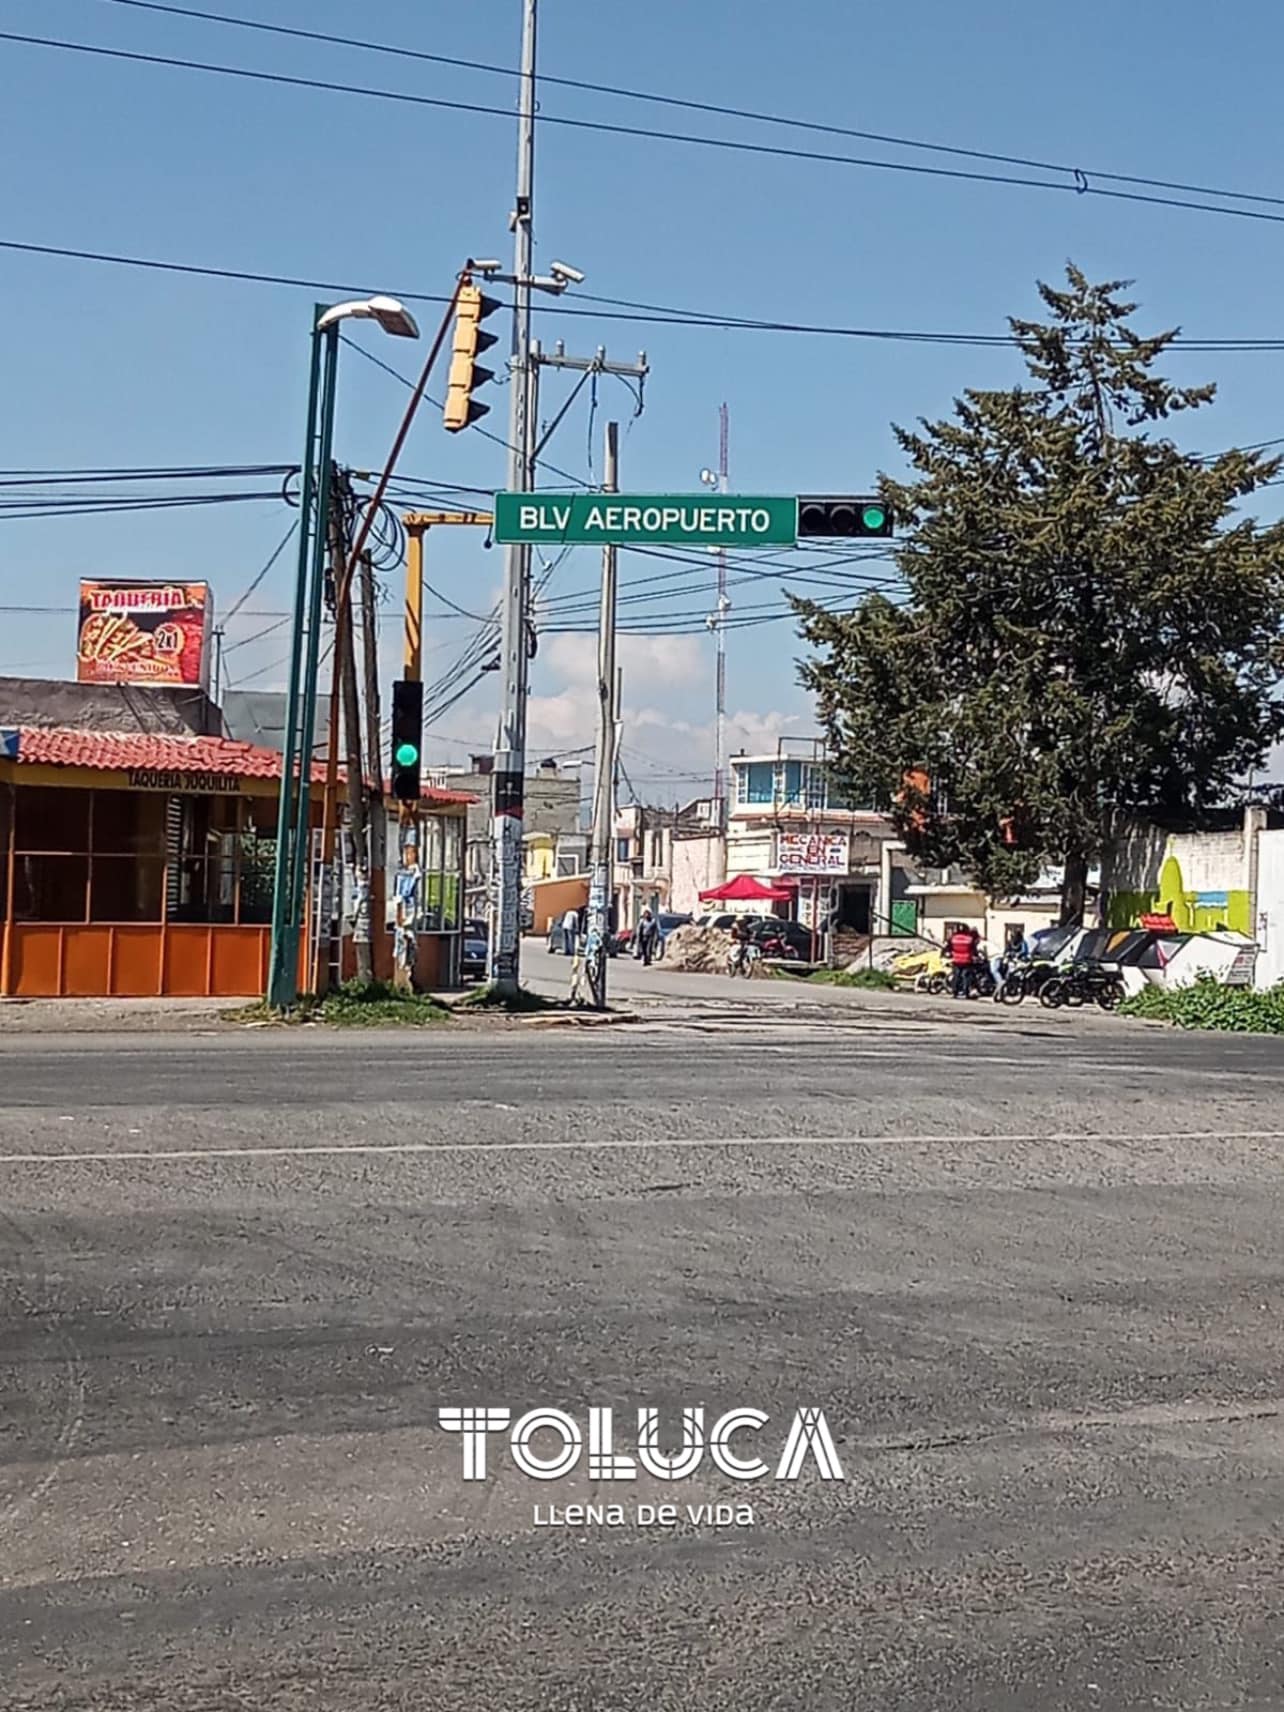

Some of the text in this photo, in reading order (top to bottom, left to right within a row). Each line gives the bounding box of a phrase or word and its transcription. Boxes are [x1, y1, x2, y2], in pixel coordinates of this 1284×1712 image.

[519, 506, 771, 533] BLV AEROPUERTO
[779, 854, 846, 866] GENERAL
